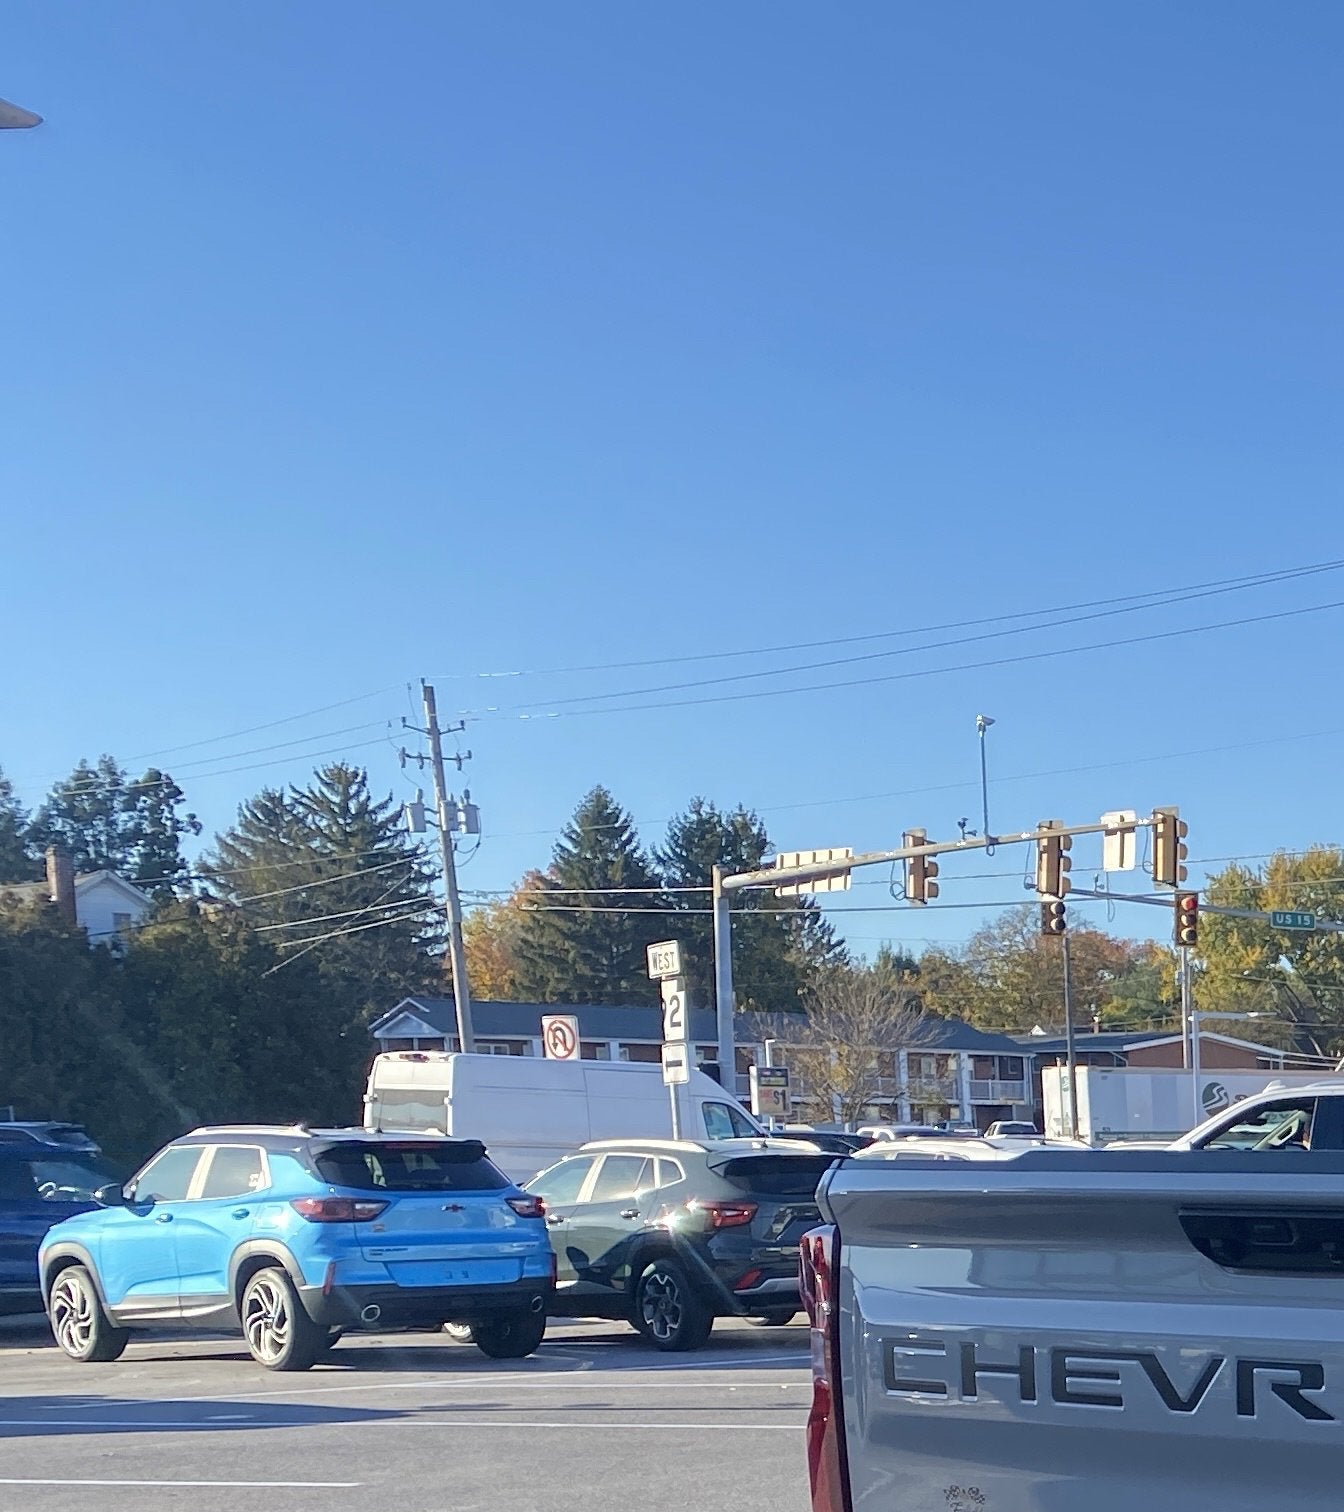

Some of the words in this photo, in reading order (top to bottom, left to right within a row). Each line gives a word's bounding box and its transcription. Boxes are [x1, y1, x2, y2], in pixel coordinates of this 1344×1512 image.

[1276, 913, 1292, 925] US
[1297, 915, 1311, 926] 15
[651, 951, 675, 971] WEST
